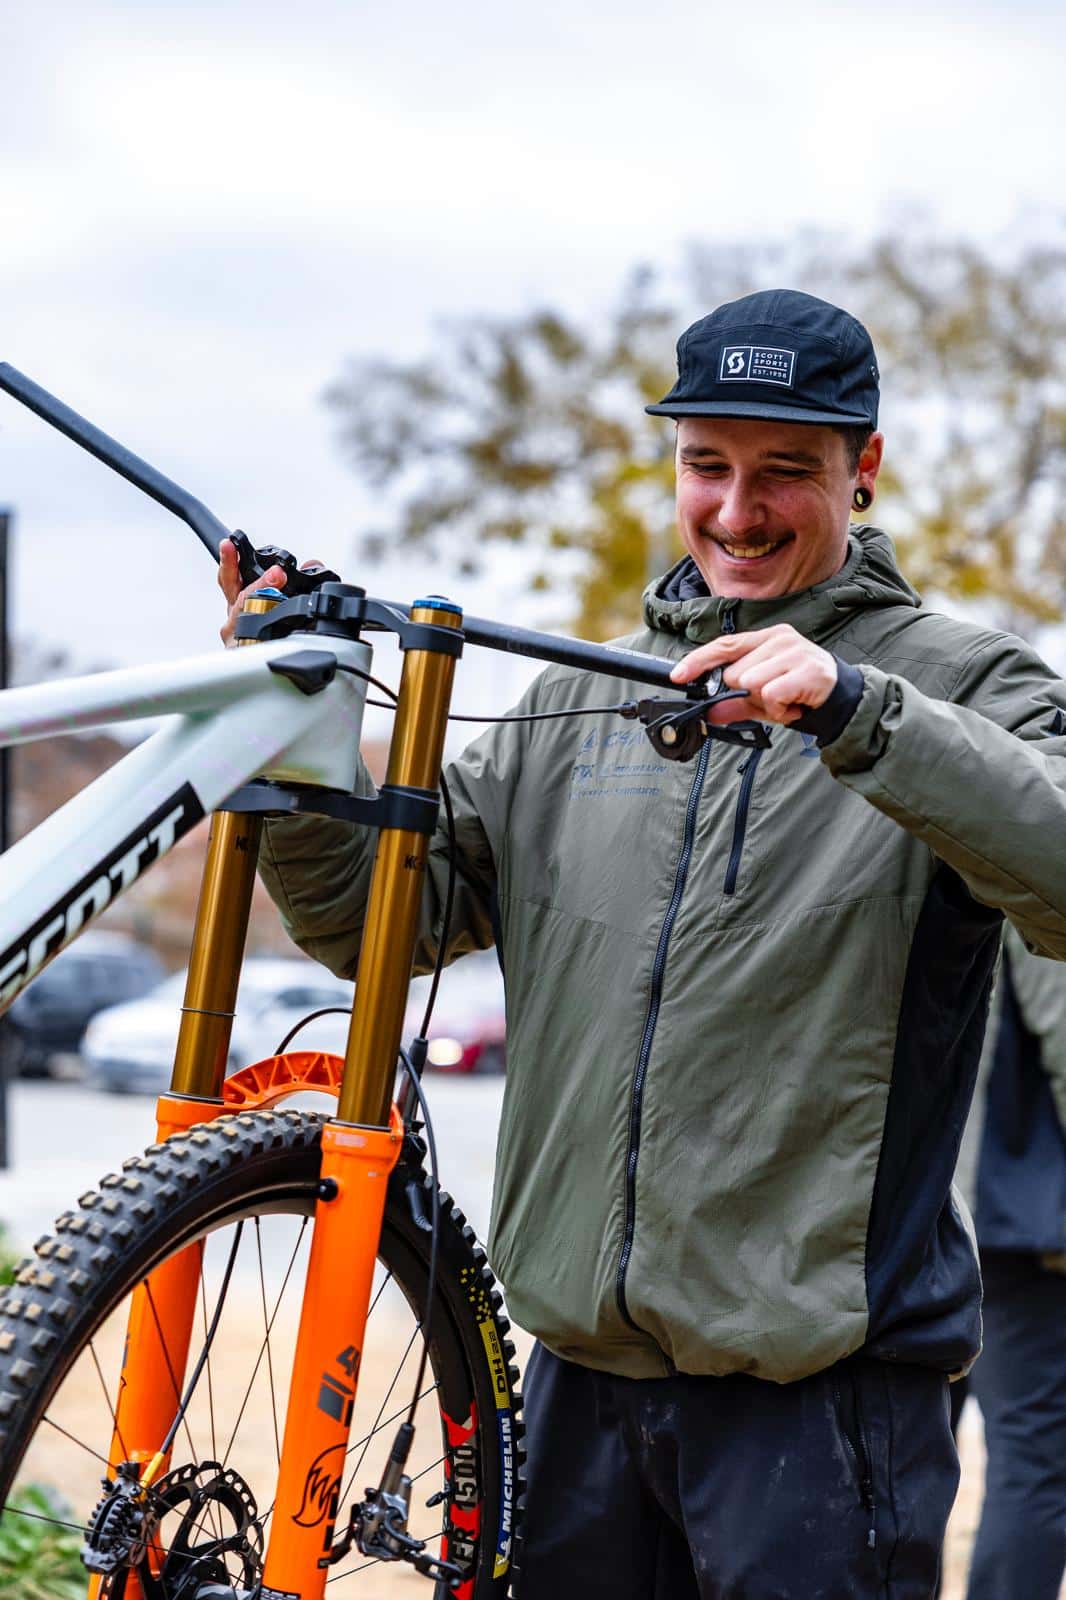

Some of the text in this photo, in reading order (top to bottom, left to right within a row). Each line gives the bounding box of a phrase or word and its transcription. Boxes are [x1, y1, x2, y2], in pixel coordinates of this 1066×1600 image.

[754, 352, 784, 360] SCOTT
[754, 358, 788, 368] SPORTS
[501, 1417, 512, 1533] MICHELIN
